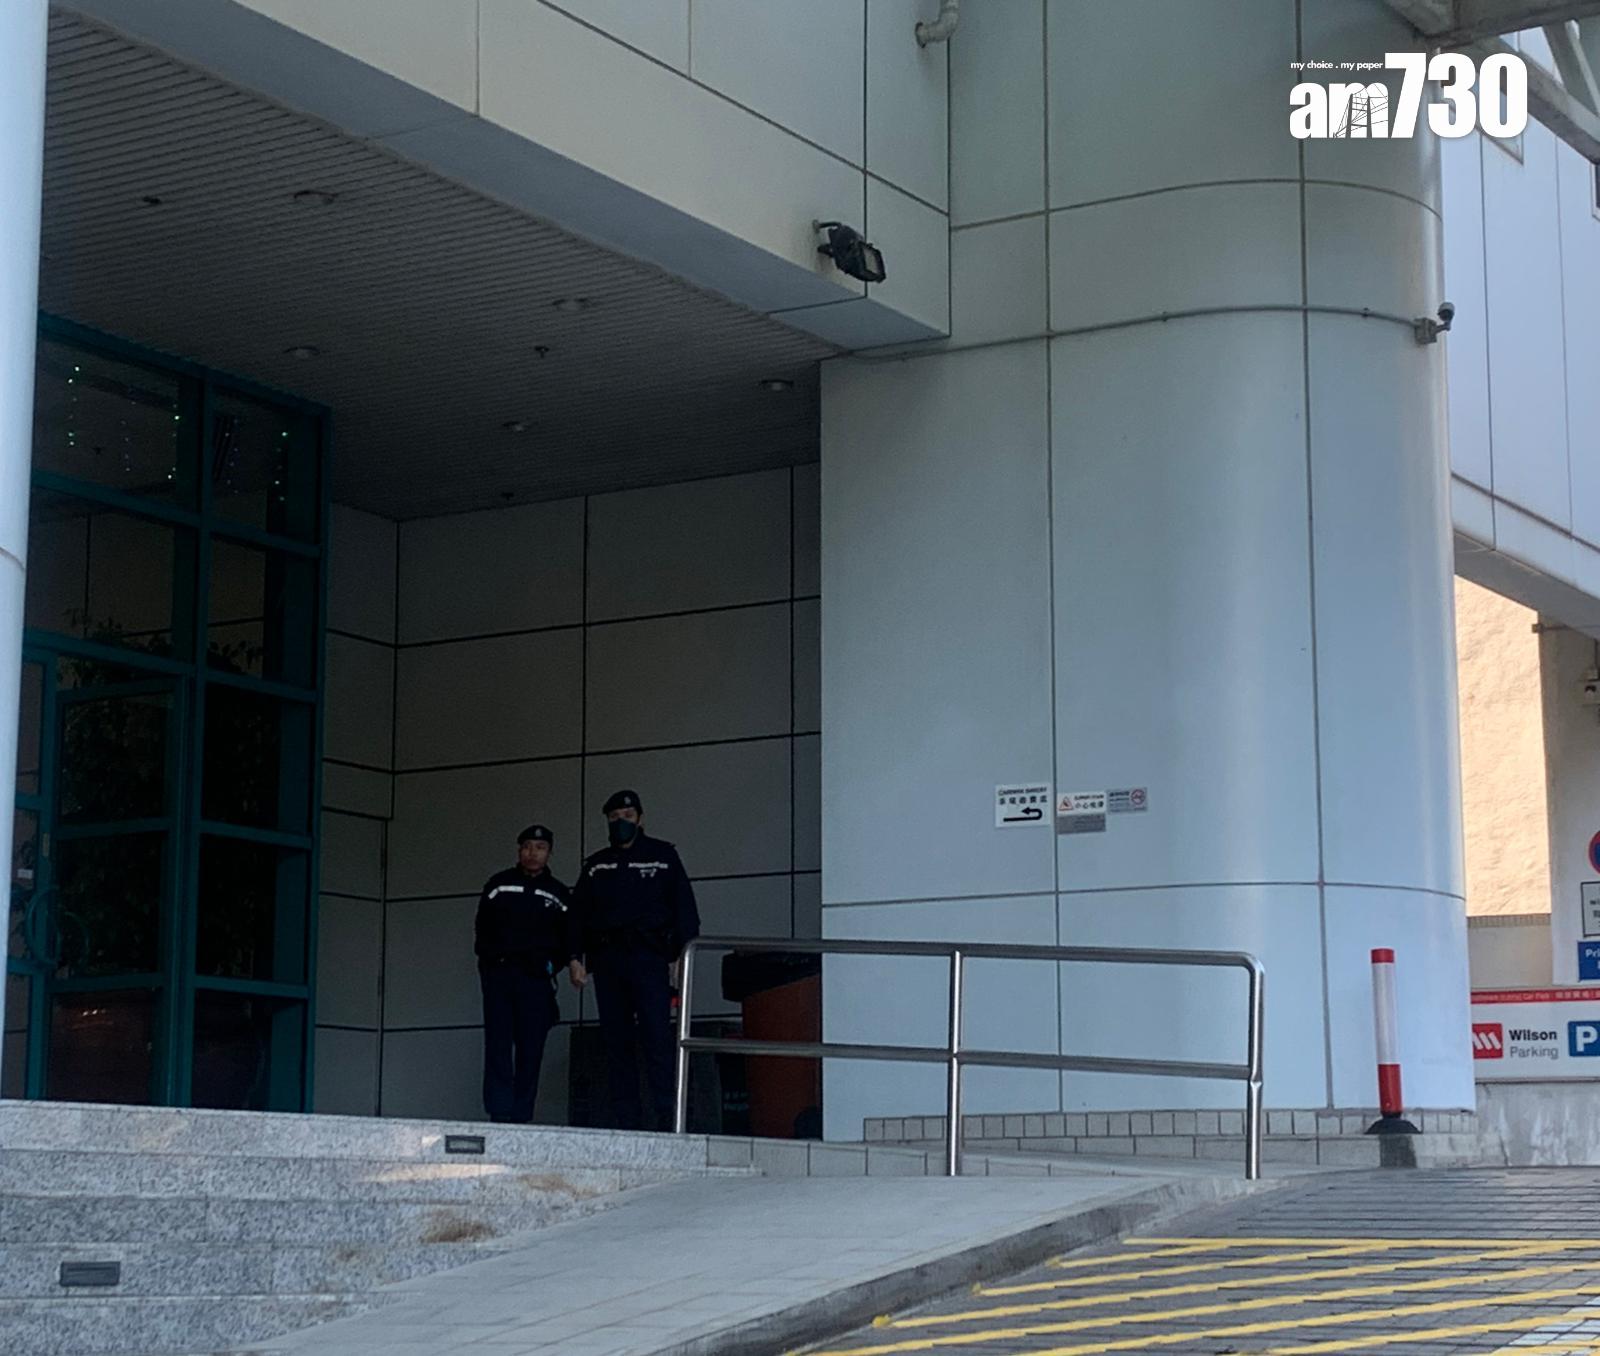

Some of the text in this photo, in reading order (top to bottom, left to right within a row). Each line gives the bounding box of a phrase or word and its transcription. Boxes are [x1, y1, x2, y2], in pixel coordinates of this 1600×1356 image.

[1509, 1029, 1557, 1041] Wilson
[1576, 1026, 1598, 1051] P
[1510, 1046, 1559, 1060] Parking
